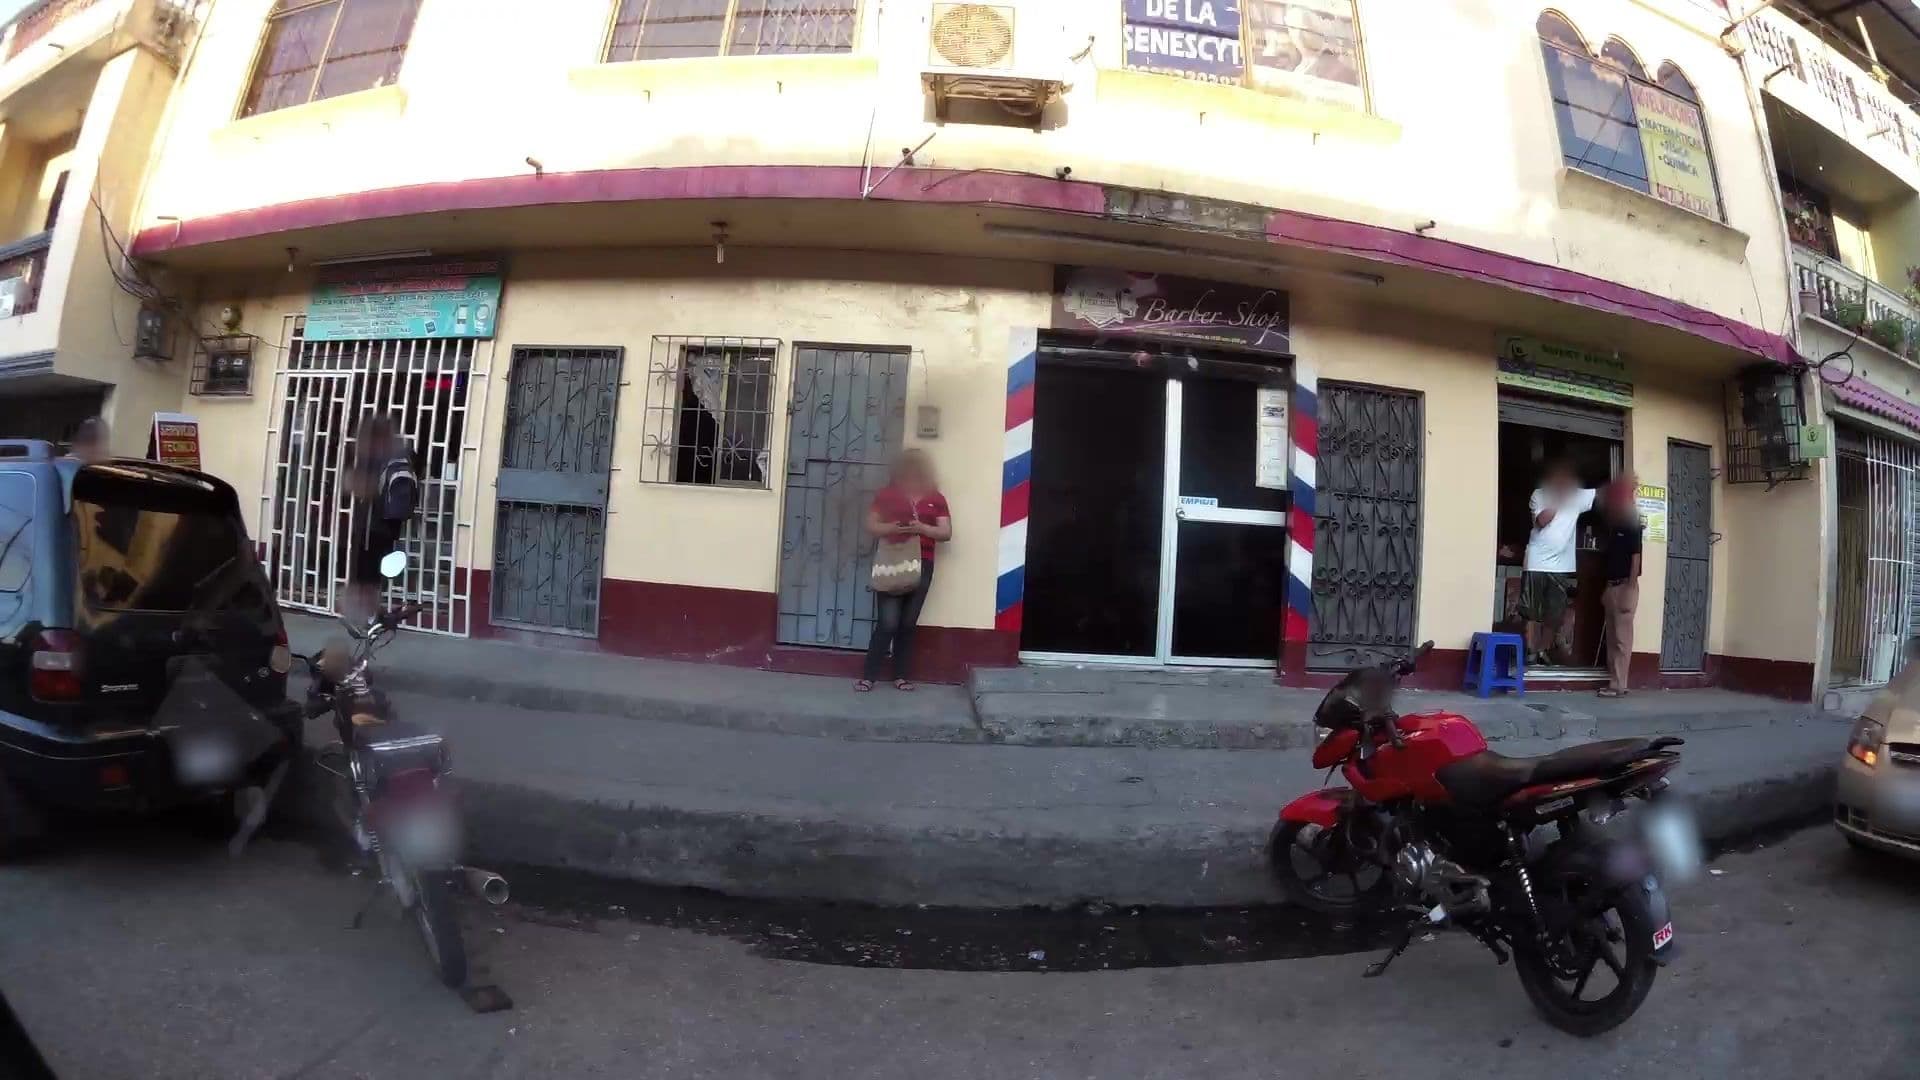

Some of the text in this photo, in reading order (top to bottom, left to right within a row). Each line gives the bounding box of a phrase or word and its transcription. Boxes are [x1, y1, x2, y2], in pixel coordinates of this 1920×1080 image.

[1146, 0, 1216, 27] DE LA
[1123, 24, 1241, 65] SENESCYT
[1142, 288, 1282, 347] Barber Shop
